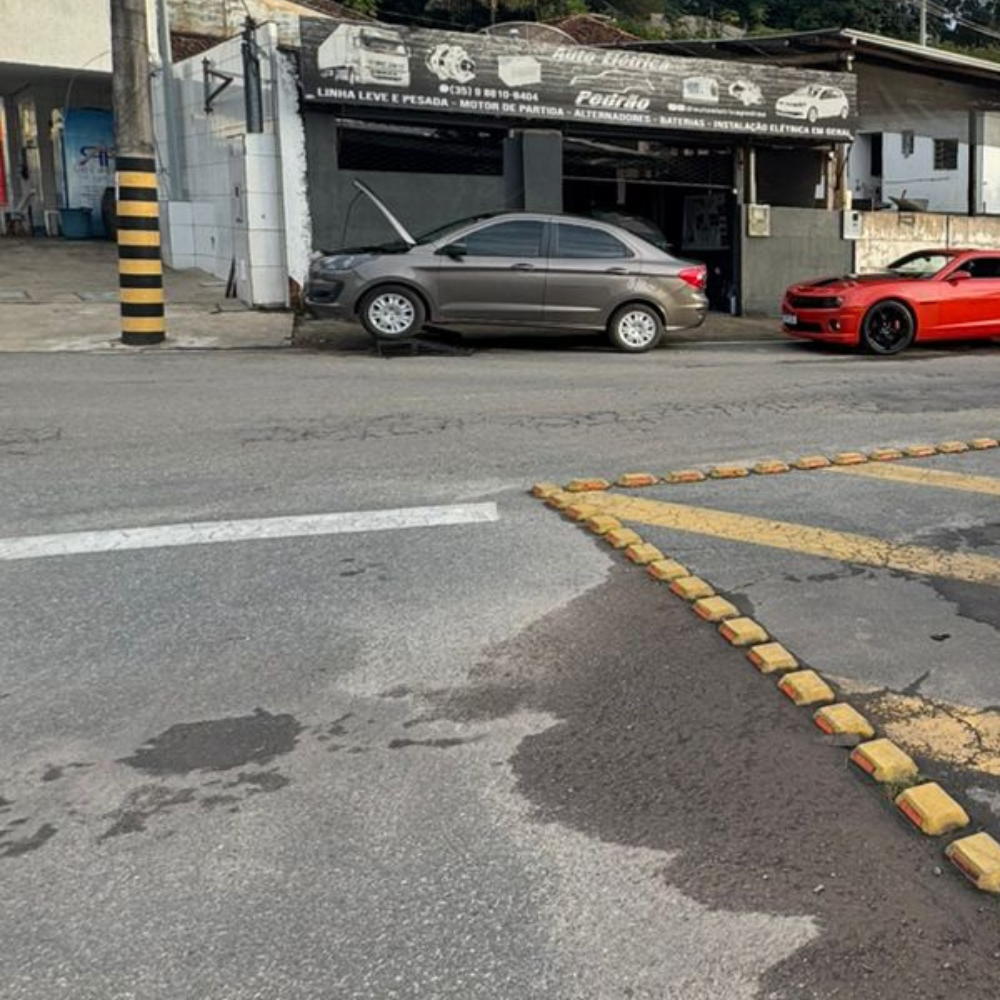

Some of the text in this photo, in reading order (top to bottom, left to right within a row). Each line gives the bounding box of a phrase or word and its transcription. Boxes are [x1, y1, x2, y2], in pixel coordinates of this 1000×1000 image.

[317, 87, 355, 100] LINHA
[358, 90, 389, 103] LEVE
[391, 92, 399, 104] E
[402, 94, 449, 107] PESADA
[459, 99, 500, 111] MOTOR
[502, 102, 516, 112] DE
[519, 104, 564, 116] PARTIDA
